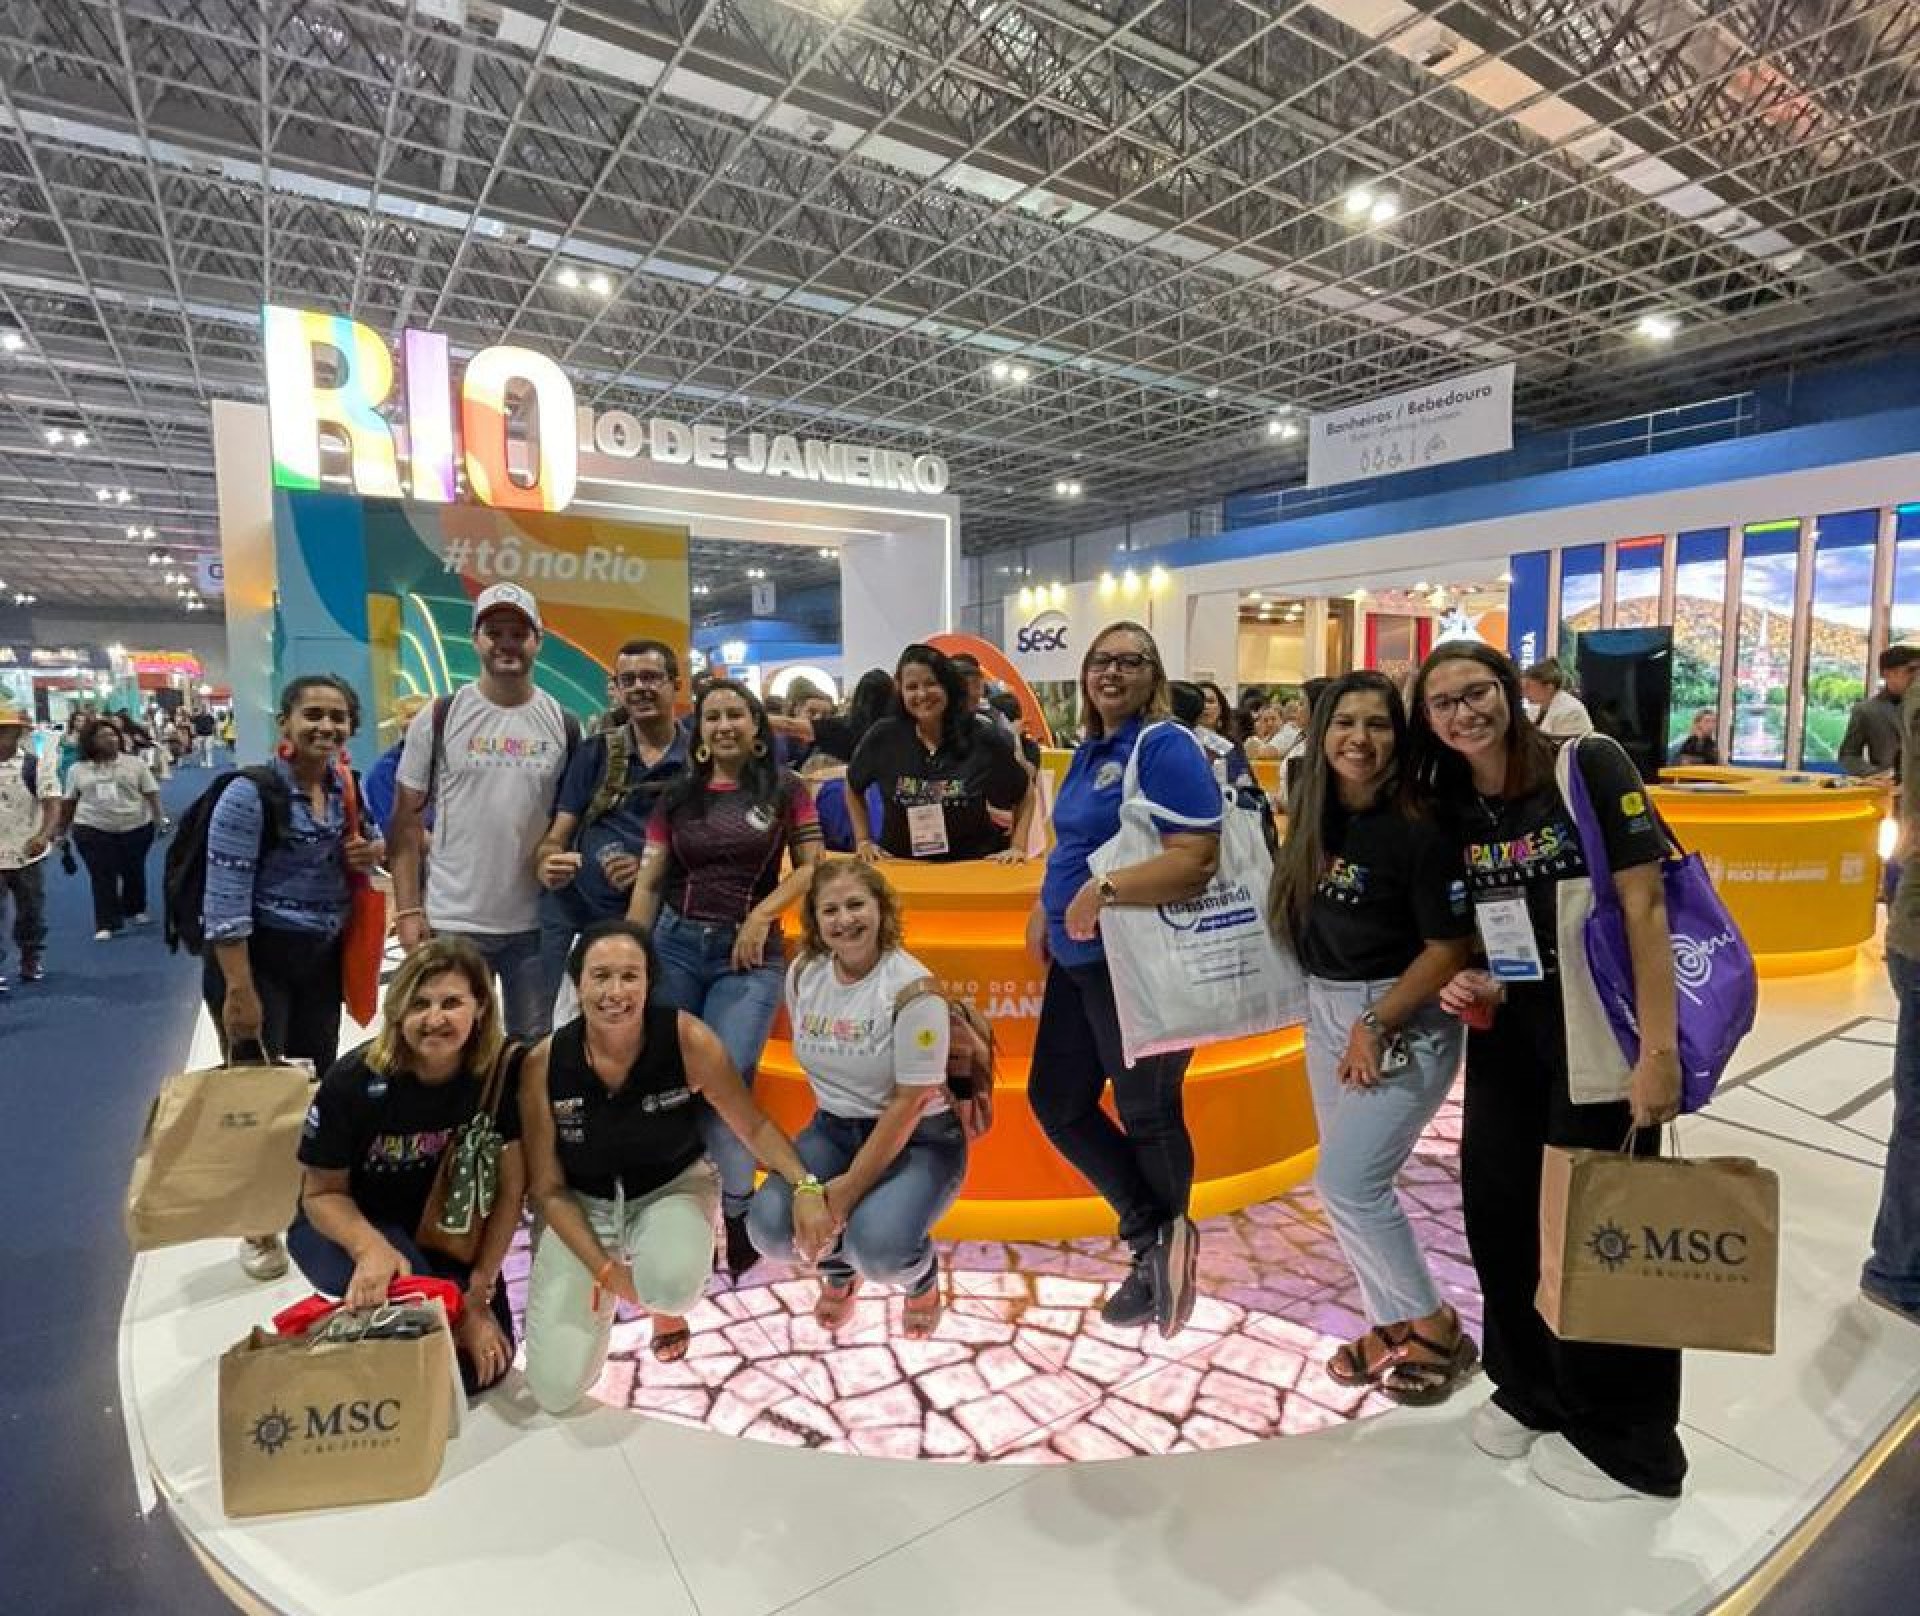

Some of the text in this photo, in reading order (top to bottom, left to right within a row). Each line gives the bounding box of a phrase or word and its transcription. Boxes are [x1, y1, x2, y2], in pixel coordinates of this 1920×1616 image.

[263, 304, 578, 513] RIO
[1407, 384, 1493, 415] Bebedouro
[576, 406, 950, 496] IO DE JANEIRO
[1641, 1225, 1749, 1267] MSC
[303, 1397, 401, 1440] MSC
